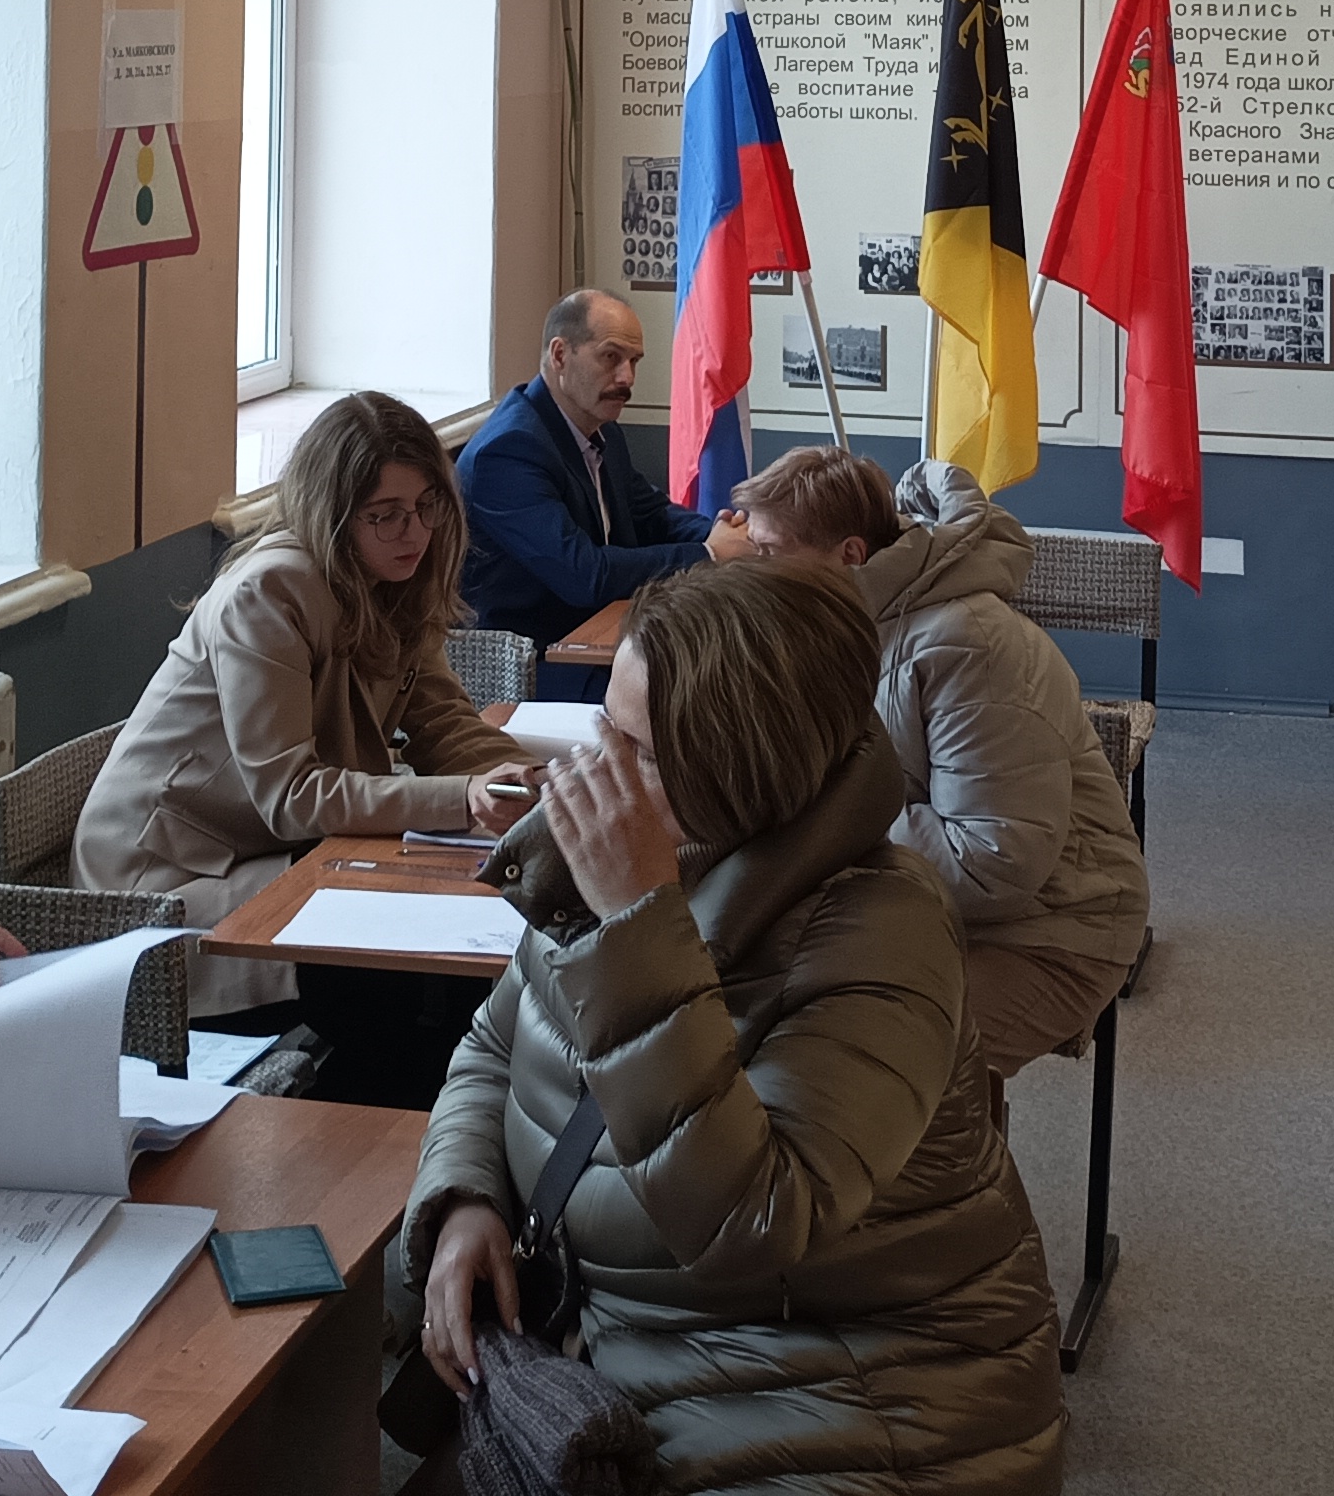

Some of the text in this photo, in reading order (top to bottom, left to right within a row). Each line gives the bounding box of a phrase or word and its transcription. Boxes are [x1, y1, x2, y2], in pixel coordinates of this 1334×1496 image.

[1174, 2, 1298, 18] оявились
[622, 11, 634, 25] в
[752, 12, 820, 30] страны
[833, 13, 892, 27] своим
[863, 32, 934, 53] "Маяк",
[1173, 27, 1287, 45] ворческие
[125, 44, 175, 58] МАЯКОВСКОГО
[1225, 47, 1320, 69] Единой
[773, 55, 854, 76] Лагерем
[862, 55, 919, 78] Труда
[928, 61, 939, 74] и
[798, 82, 914, 97] воспитание
[1182, 71, 1230, 90] 1974
[1236, 76, 1281, 93] года
[849, 106, 918, 121] школы.
[1189, 119, 1282, 142] Красного
[1188, 148, 1320, 167] ветеранами
[1277, 175, 1289, 188] и
[1296, 175, 1321, 190] по
